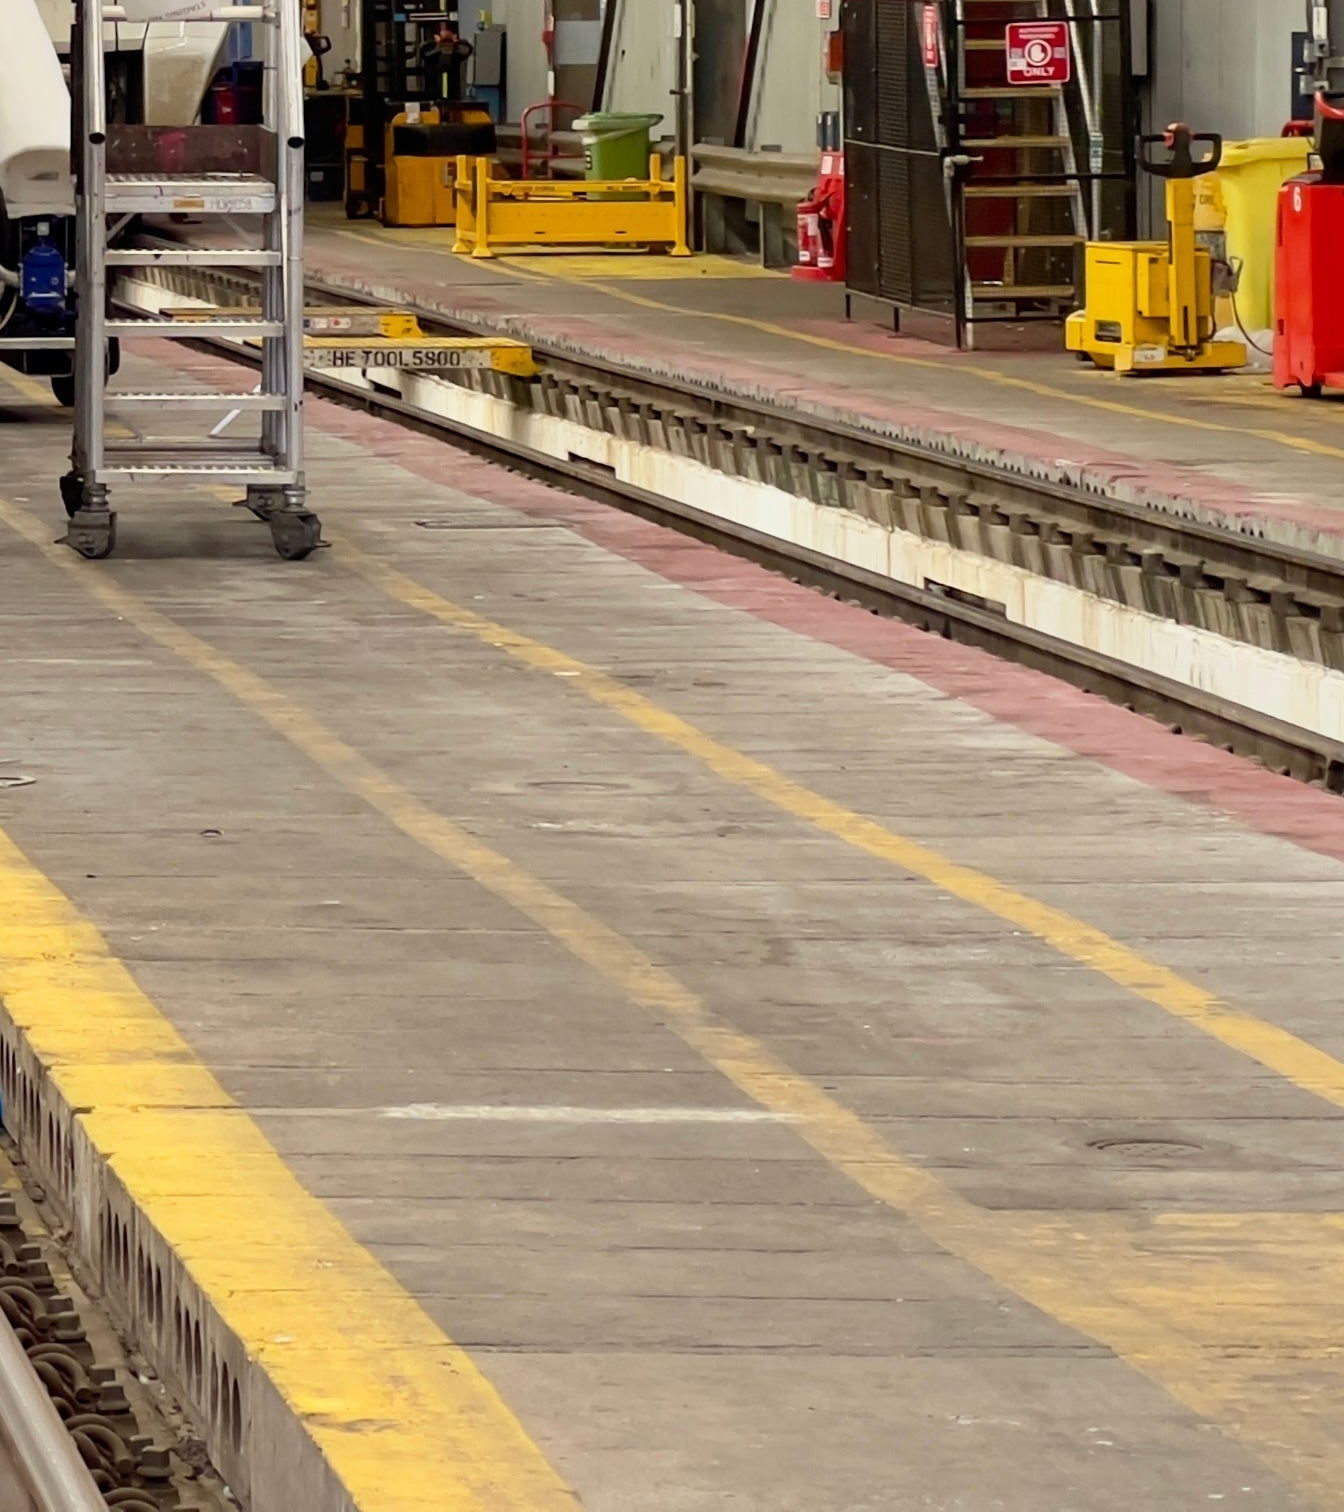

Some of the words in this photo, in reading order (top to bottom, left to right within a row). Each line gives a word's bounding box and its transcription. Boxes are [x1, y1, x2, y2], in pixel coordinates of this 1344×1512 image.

[1023, 66, 1055, 77] ONLY
[1293, 186, 1302, 213] 6
[332, 350, 356, 367] HE
[362, 350, 409, 367] TOOL
